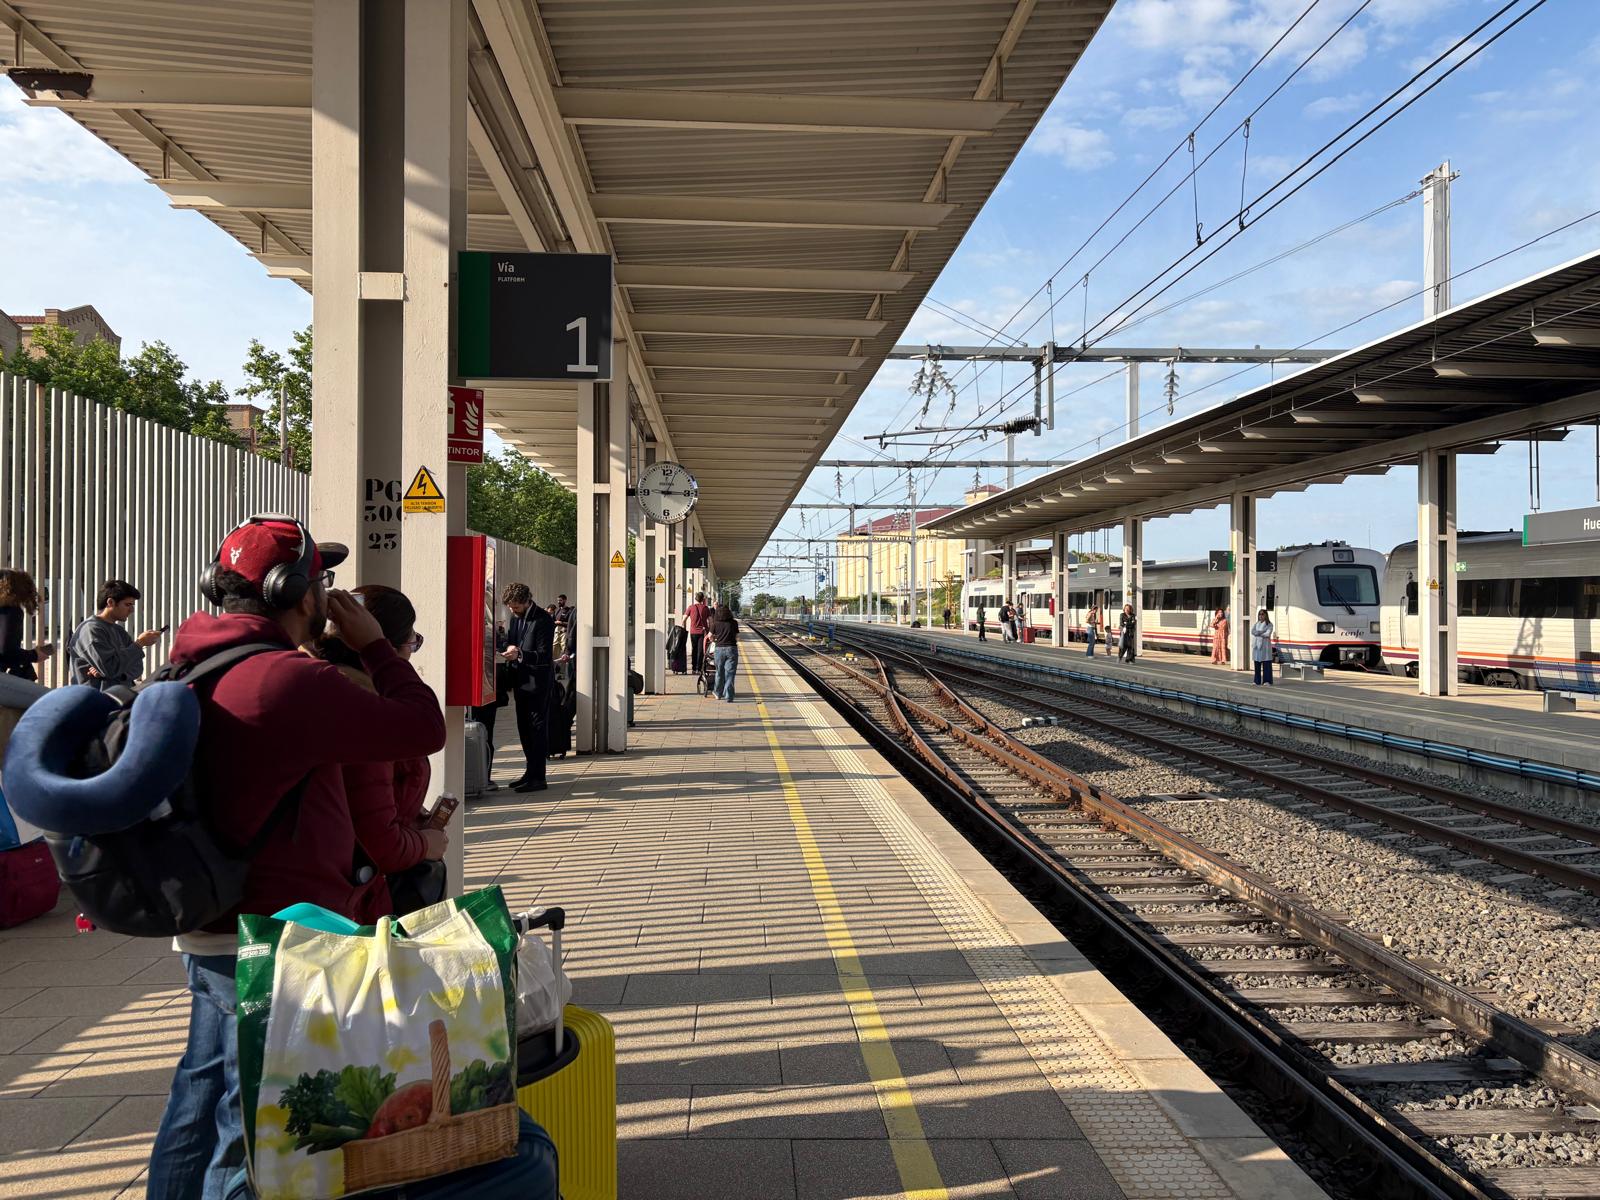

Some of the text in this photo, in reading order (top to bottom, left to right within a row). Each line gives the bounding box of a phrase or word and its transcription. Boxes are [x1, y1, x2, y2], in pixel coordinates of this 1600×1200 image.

[497, 261, 515, 273] Vía
[566, 317, 599, 372] 1
[365, 478, 402, 502] PG
[700, 557, 706, 568] 1
[1211, 560, 1218, 571] 2
[1270, 561, 1276, 571] 3
